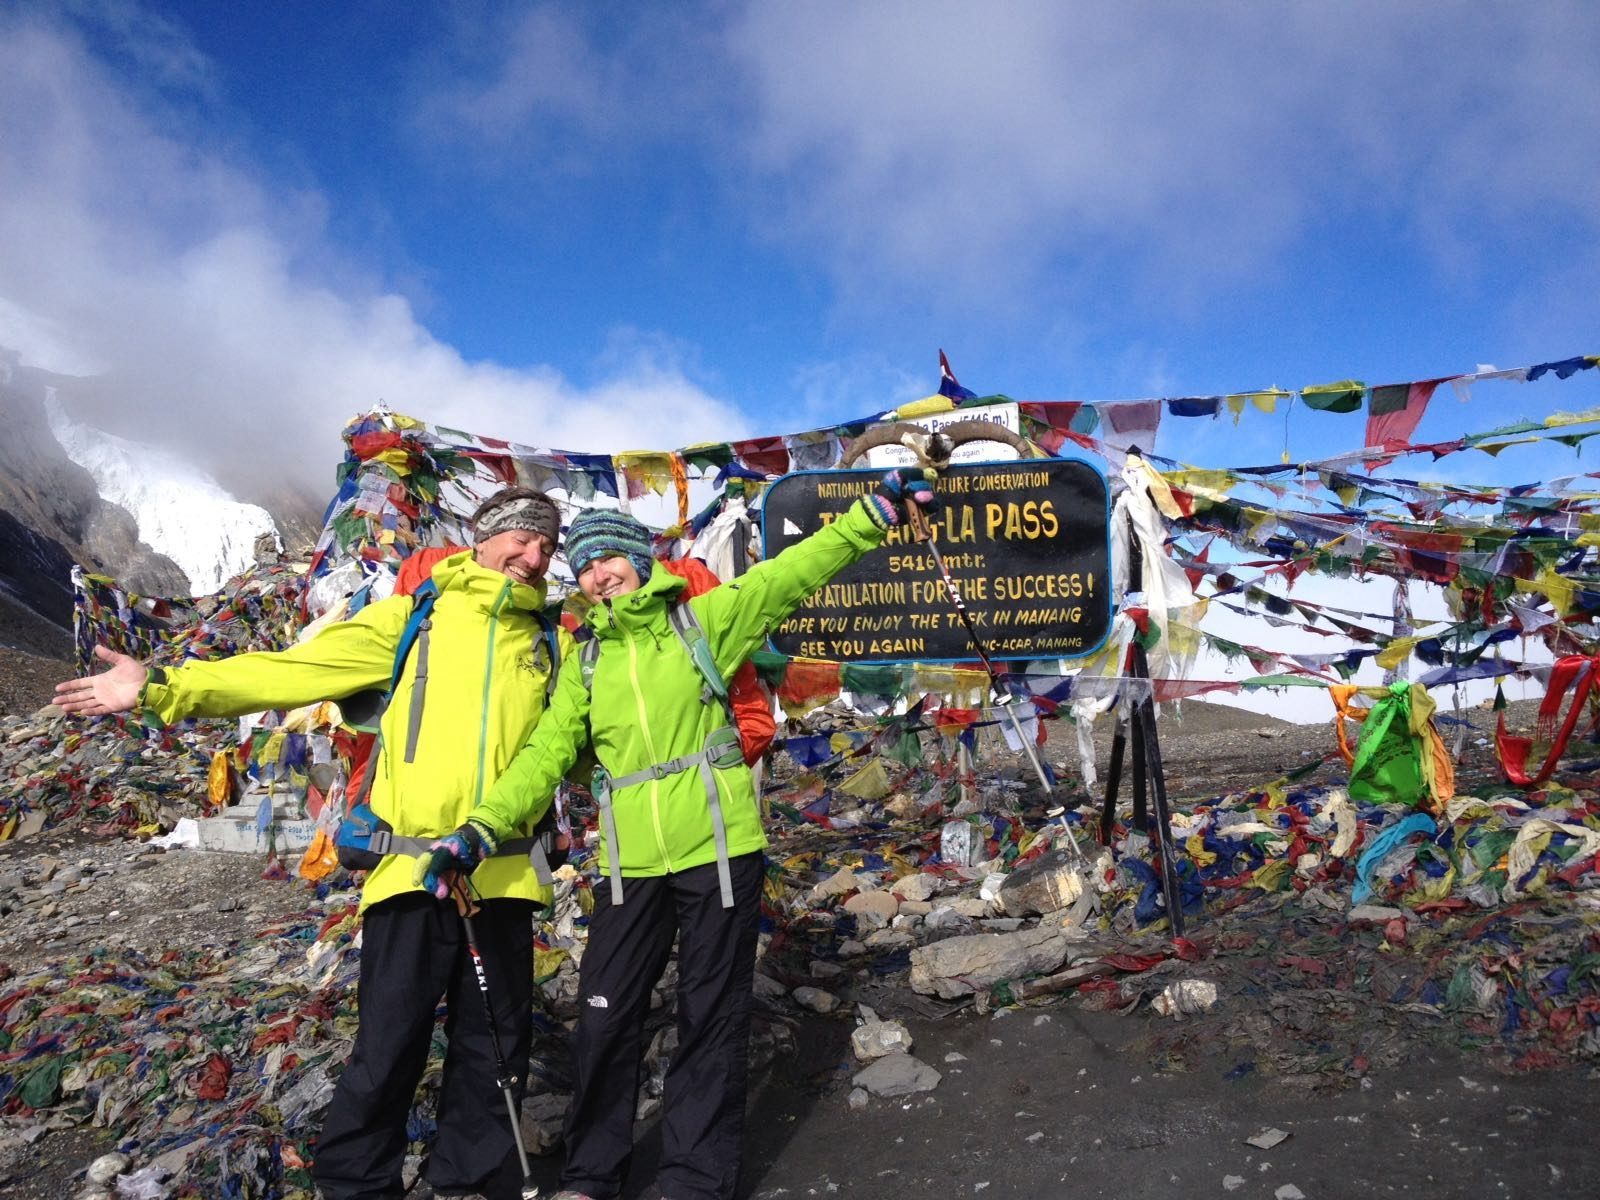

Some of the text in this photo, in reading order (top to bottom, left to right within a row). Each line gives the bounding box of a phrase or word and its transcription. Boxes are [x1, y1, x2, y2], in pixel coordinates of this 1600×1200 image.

[818, 482, 865, 498] NATIONAL
[973, 472, 1049, 492] CONSERVATION
[985, 500, 1059, 542] PASS
[889, 552, 986, 573] 5416 mtr.
[912, 579, 950, 604] FOR
[951, 577, 988, 602] THE
[820, 616, 848, 634] YOU
[853, 614, 904, 633] ENJOY
[910, 612, 941, 630] THE
[993, 609, 1012, 627] IN
[1014, 606, 1083, 627] MANANG
[800, 637, 926, 658] SEE YOU AGAIN
[1036, 636, 1083, 649] MANANG
[473, 956, 489, 991] LEKI
